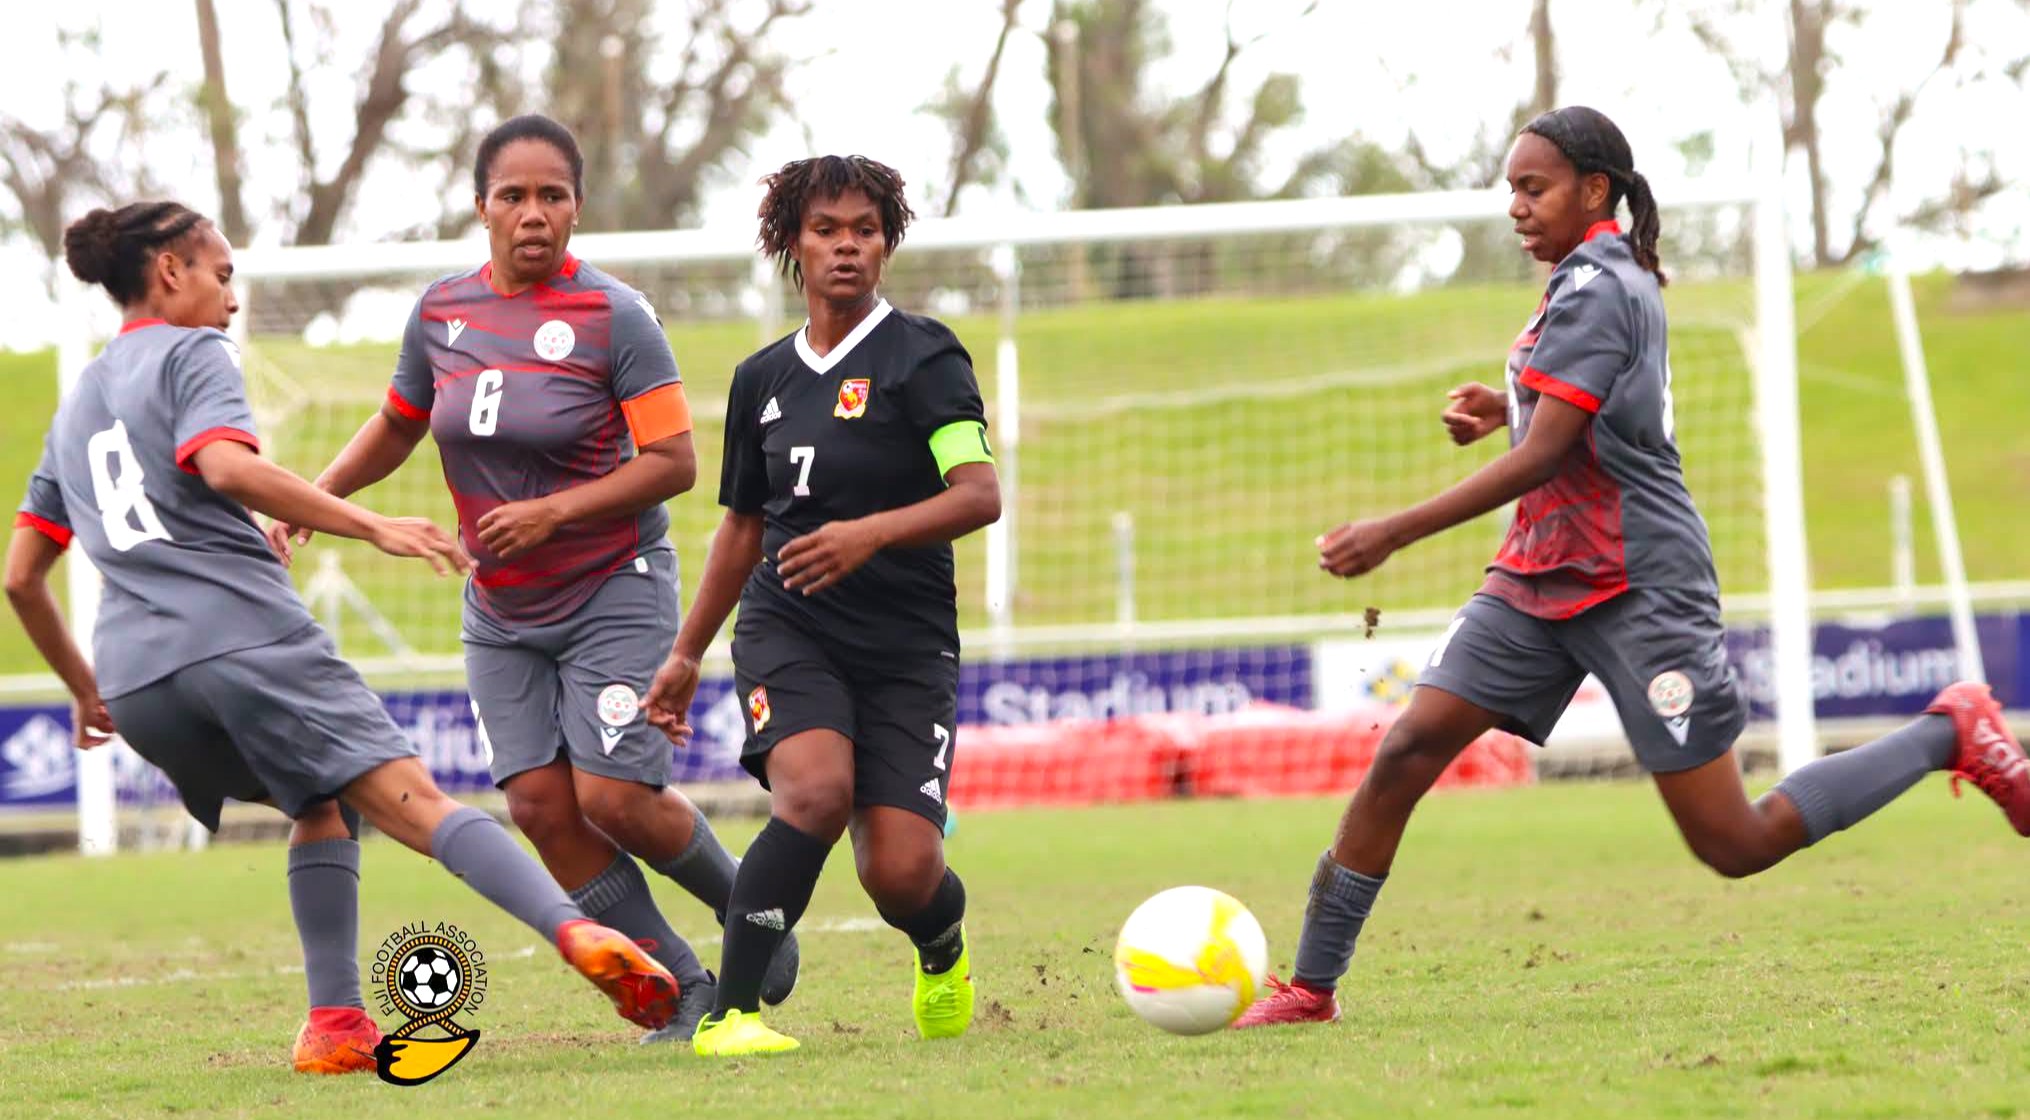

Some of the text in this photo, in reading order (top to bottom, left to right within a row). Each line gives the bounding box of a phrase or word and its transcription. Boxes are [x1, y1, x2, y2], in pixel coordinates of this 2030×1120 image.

[468, 369, 503, 437] 6
[87, 418, 174, 552] 8
[790, 446, 815, 496] 7
[1744, 638, 1960, 702] Sadium
[933, 722, 949, 771] 7
